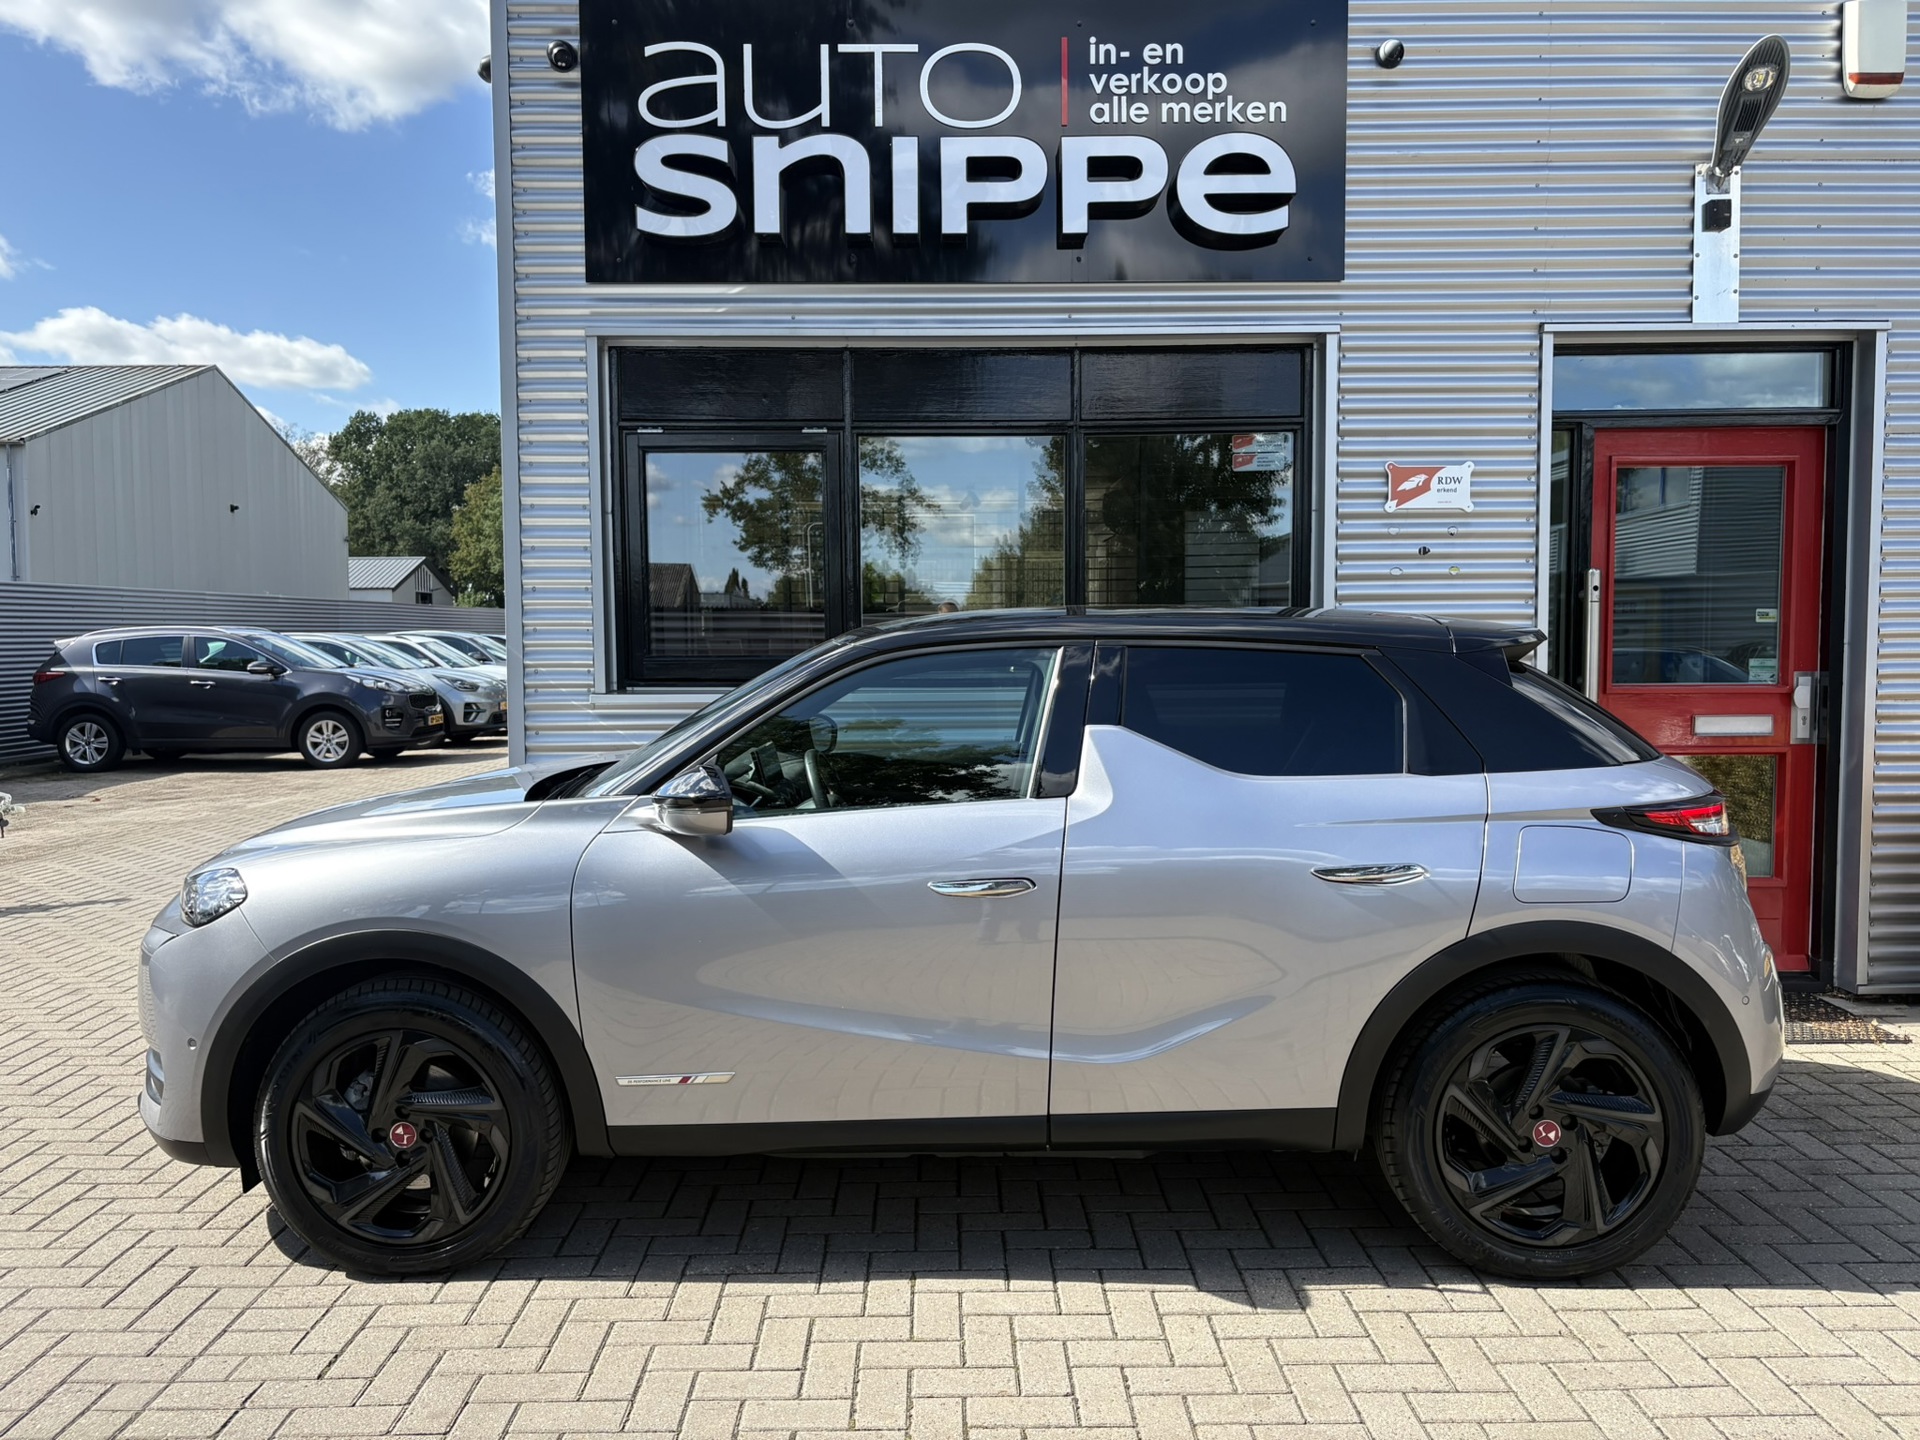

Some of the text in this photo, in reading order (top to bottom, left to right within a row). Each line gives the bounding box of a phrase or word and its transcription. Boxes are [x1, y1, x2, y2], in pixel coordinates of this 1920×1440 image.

[1088, 36, 1184, 65] in- en
[1089, 66, 1228, 100] verkoop
[1089, 95, 1288, 124] alle merken
[1437, 476, 1463, 485] RDW
